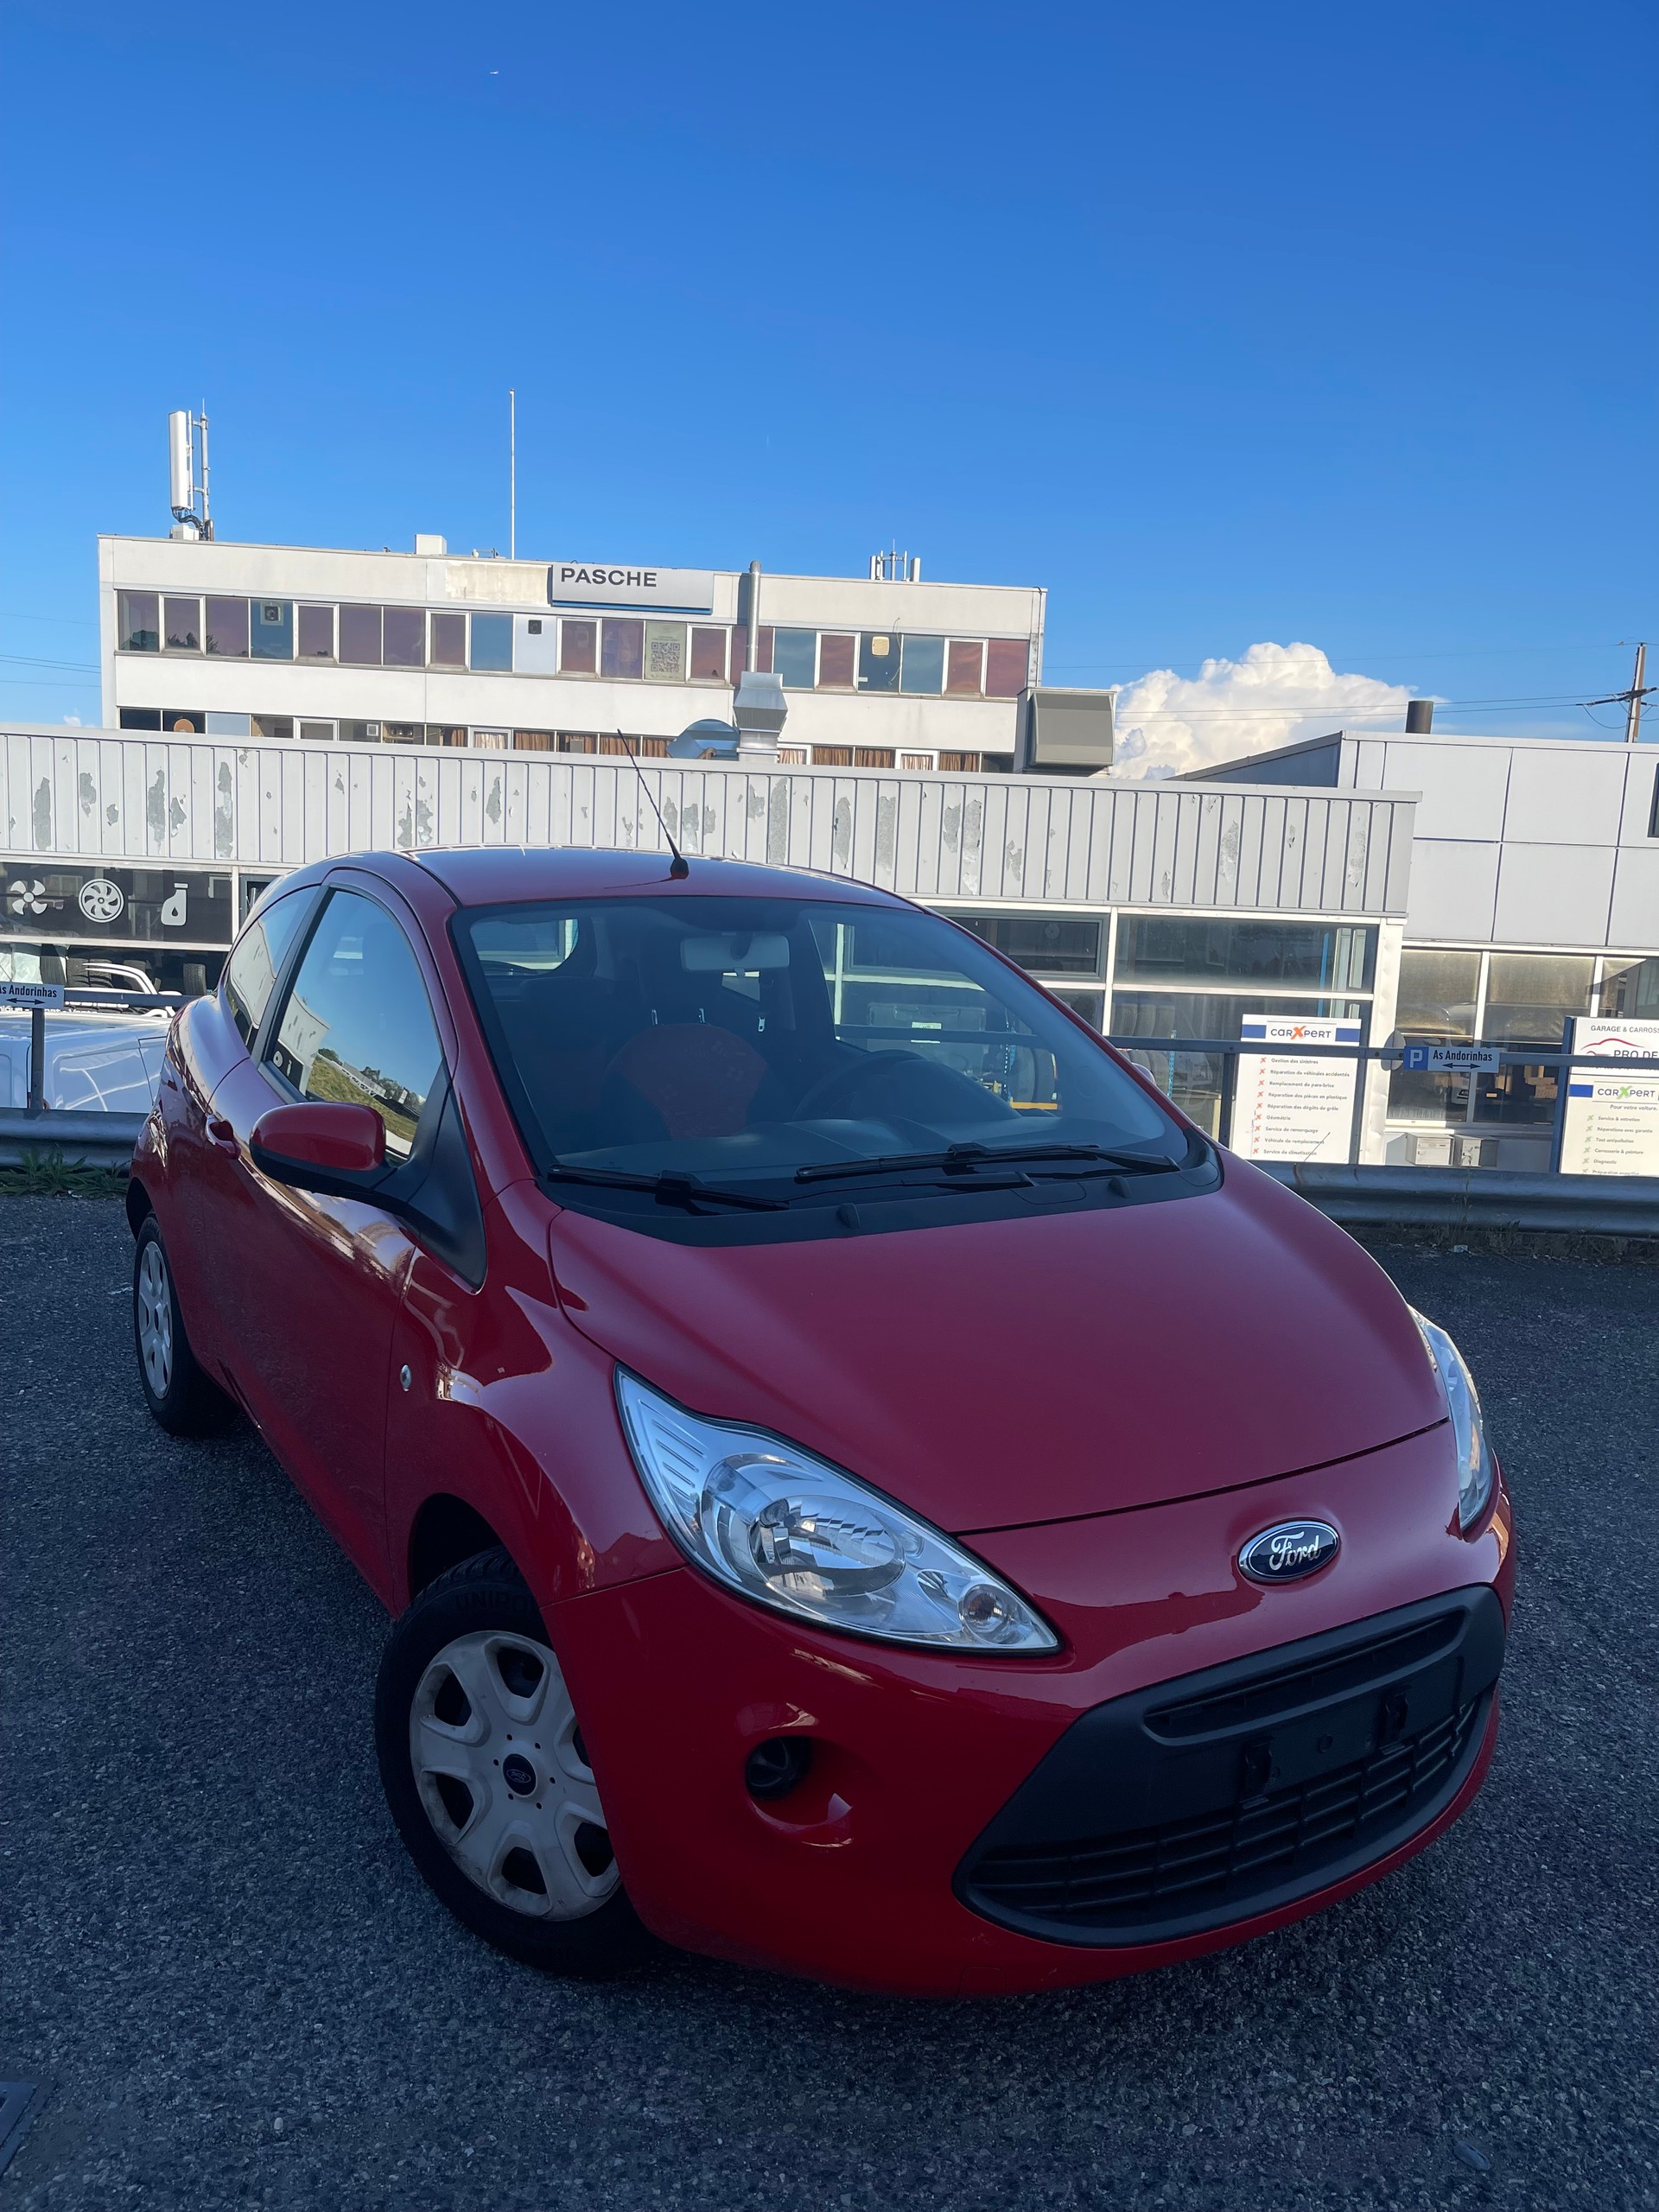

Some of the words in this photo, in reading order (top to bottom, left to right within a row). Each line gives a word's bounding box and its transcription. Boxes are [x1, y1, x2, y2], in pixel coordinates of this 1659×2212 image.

[562, 567, 657, 588] PASCHE
[0, 985, 7, 994] s
[9, 985, 57, 997] Andorinhas
[1410, 1049, 1423, 1068] P
[1433, 1050, 1443, 1059] As
[1445, 1050, 1493, 1061] Andorinhas
[1269, 1531, 1321, 1570] Ford
[454, 1590, 531, 1612] UNIRO
